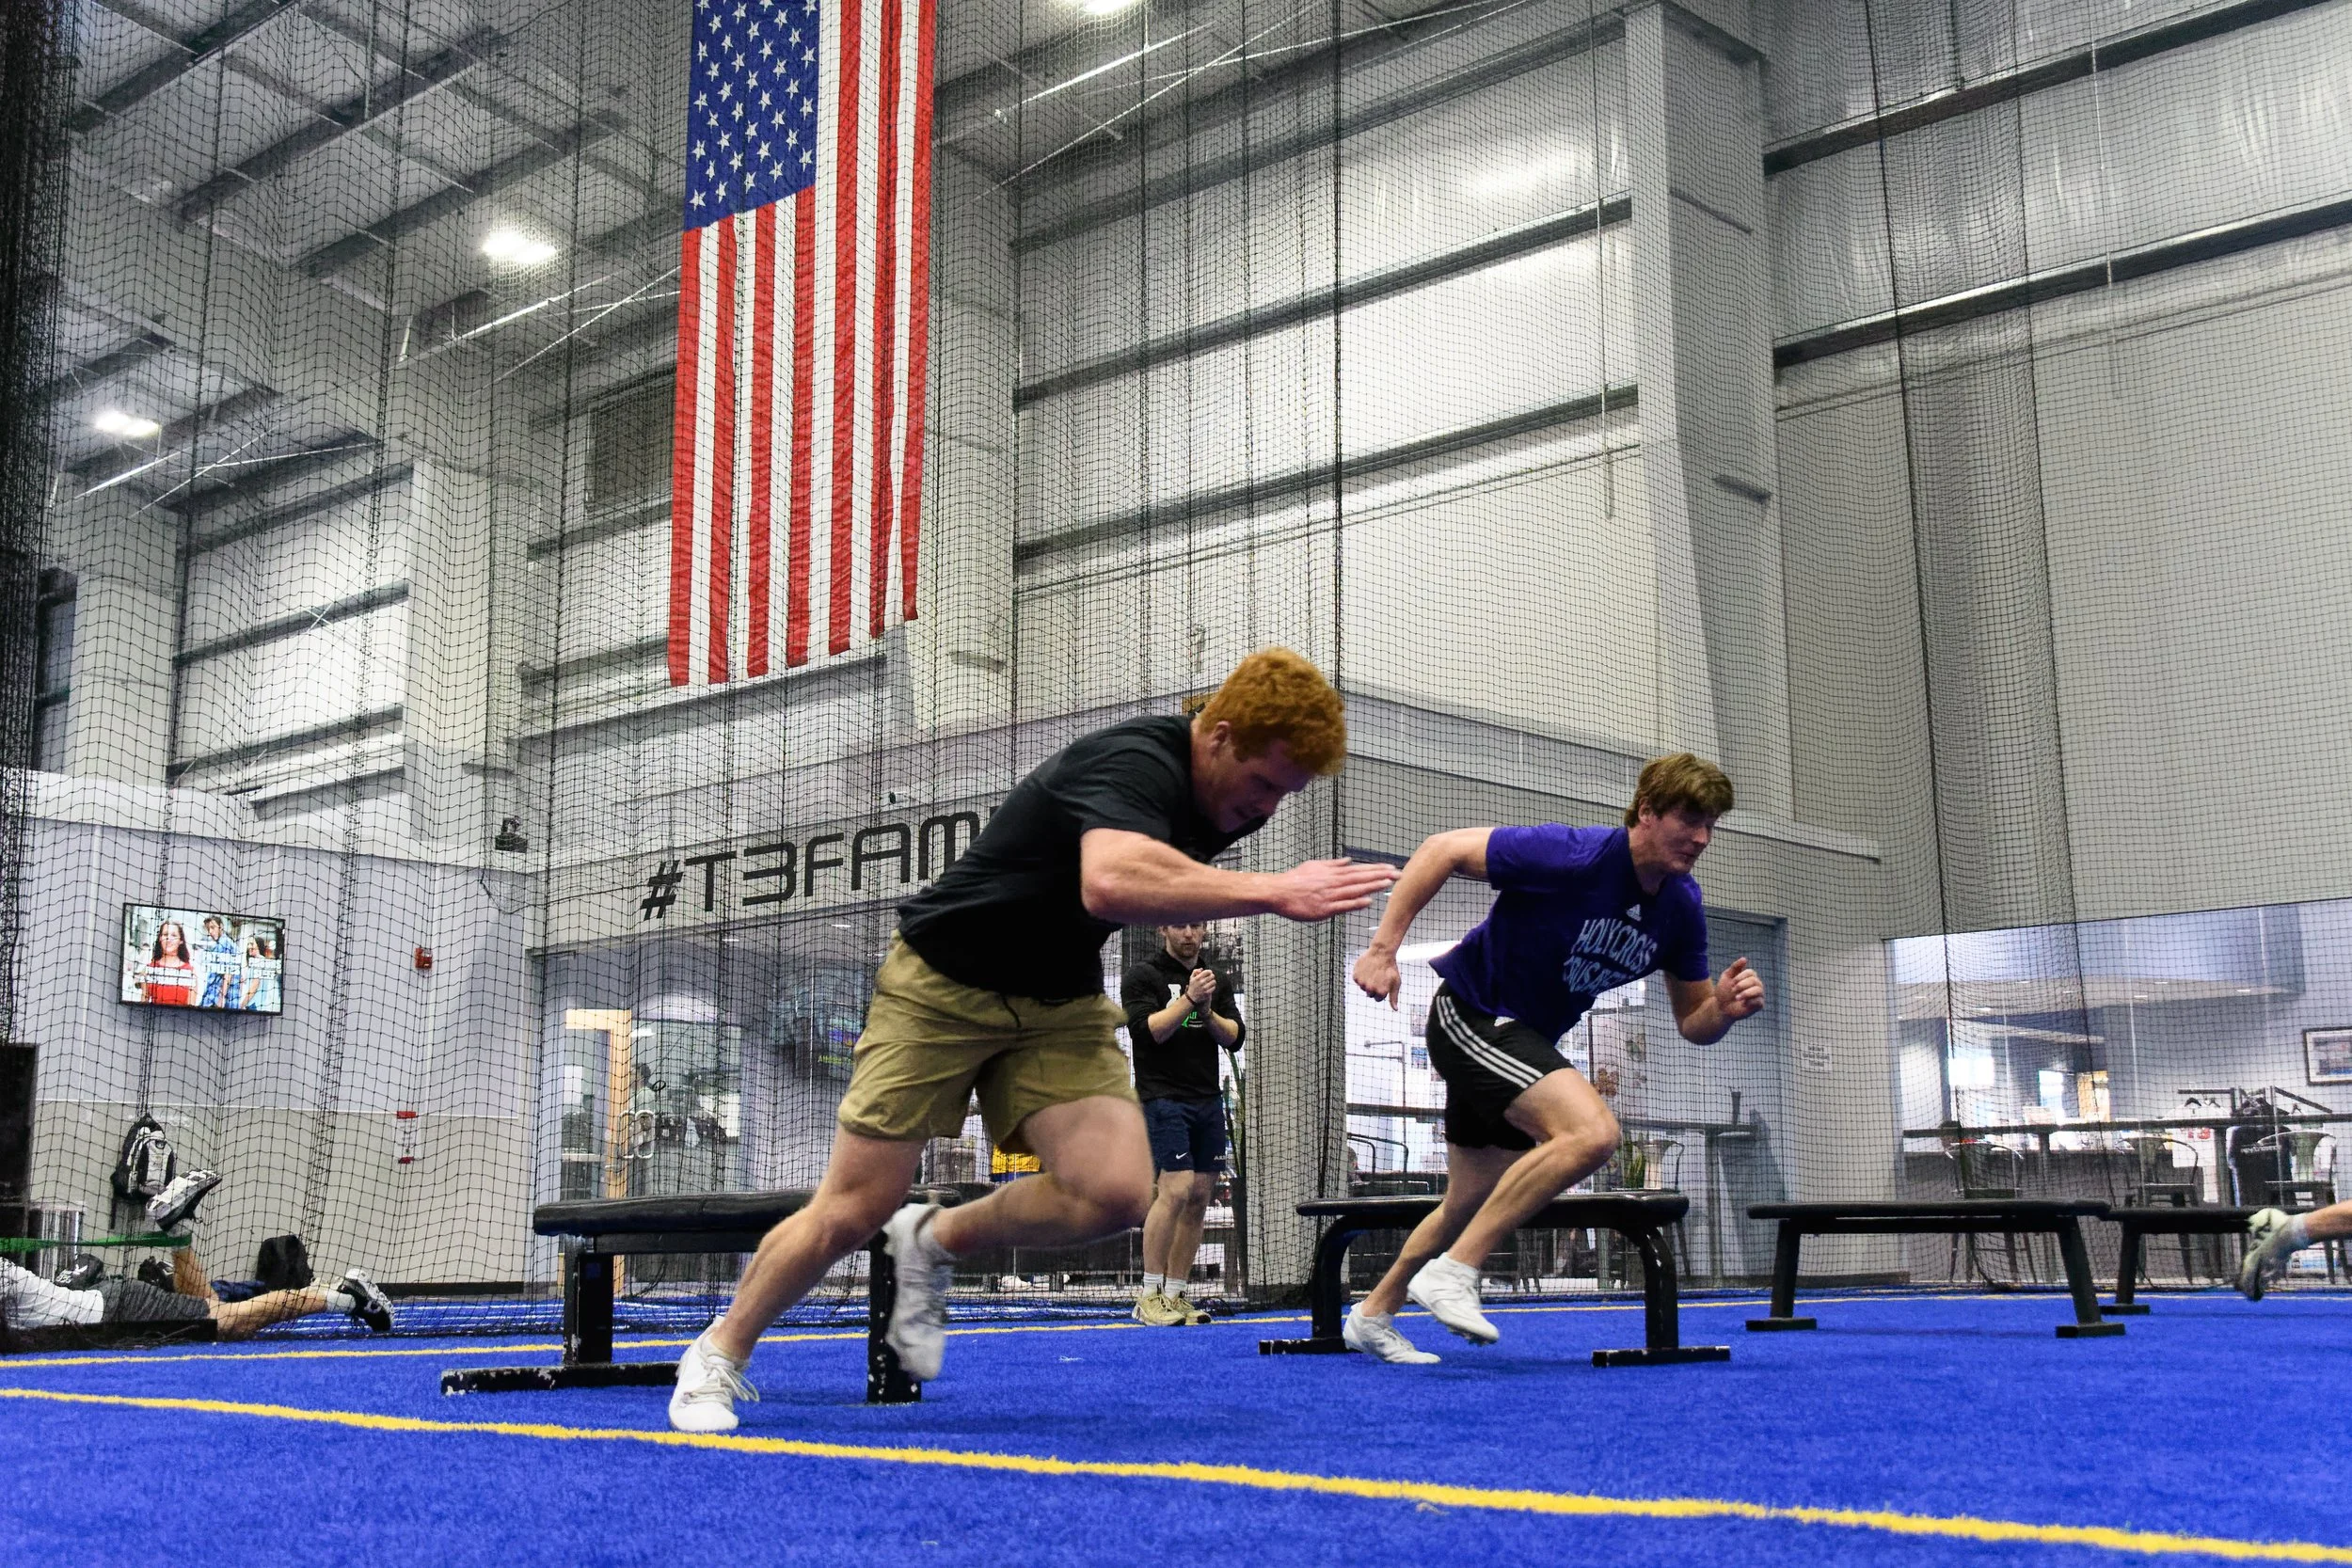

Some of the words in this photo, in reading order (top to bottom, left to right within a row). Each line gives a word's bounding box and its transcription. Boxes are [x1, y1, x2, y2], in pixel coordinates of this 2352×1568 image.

[640, 806, 999, 921] #T3FAM
[1570, 918, 1623, 956] HOLY
[1608, 925, 1659, 974] CROSS
